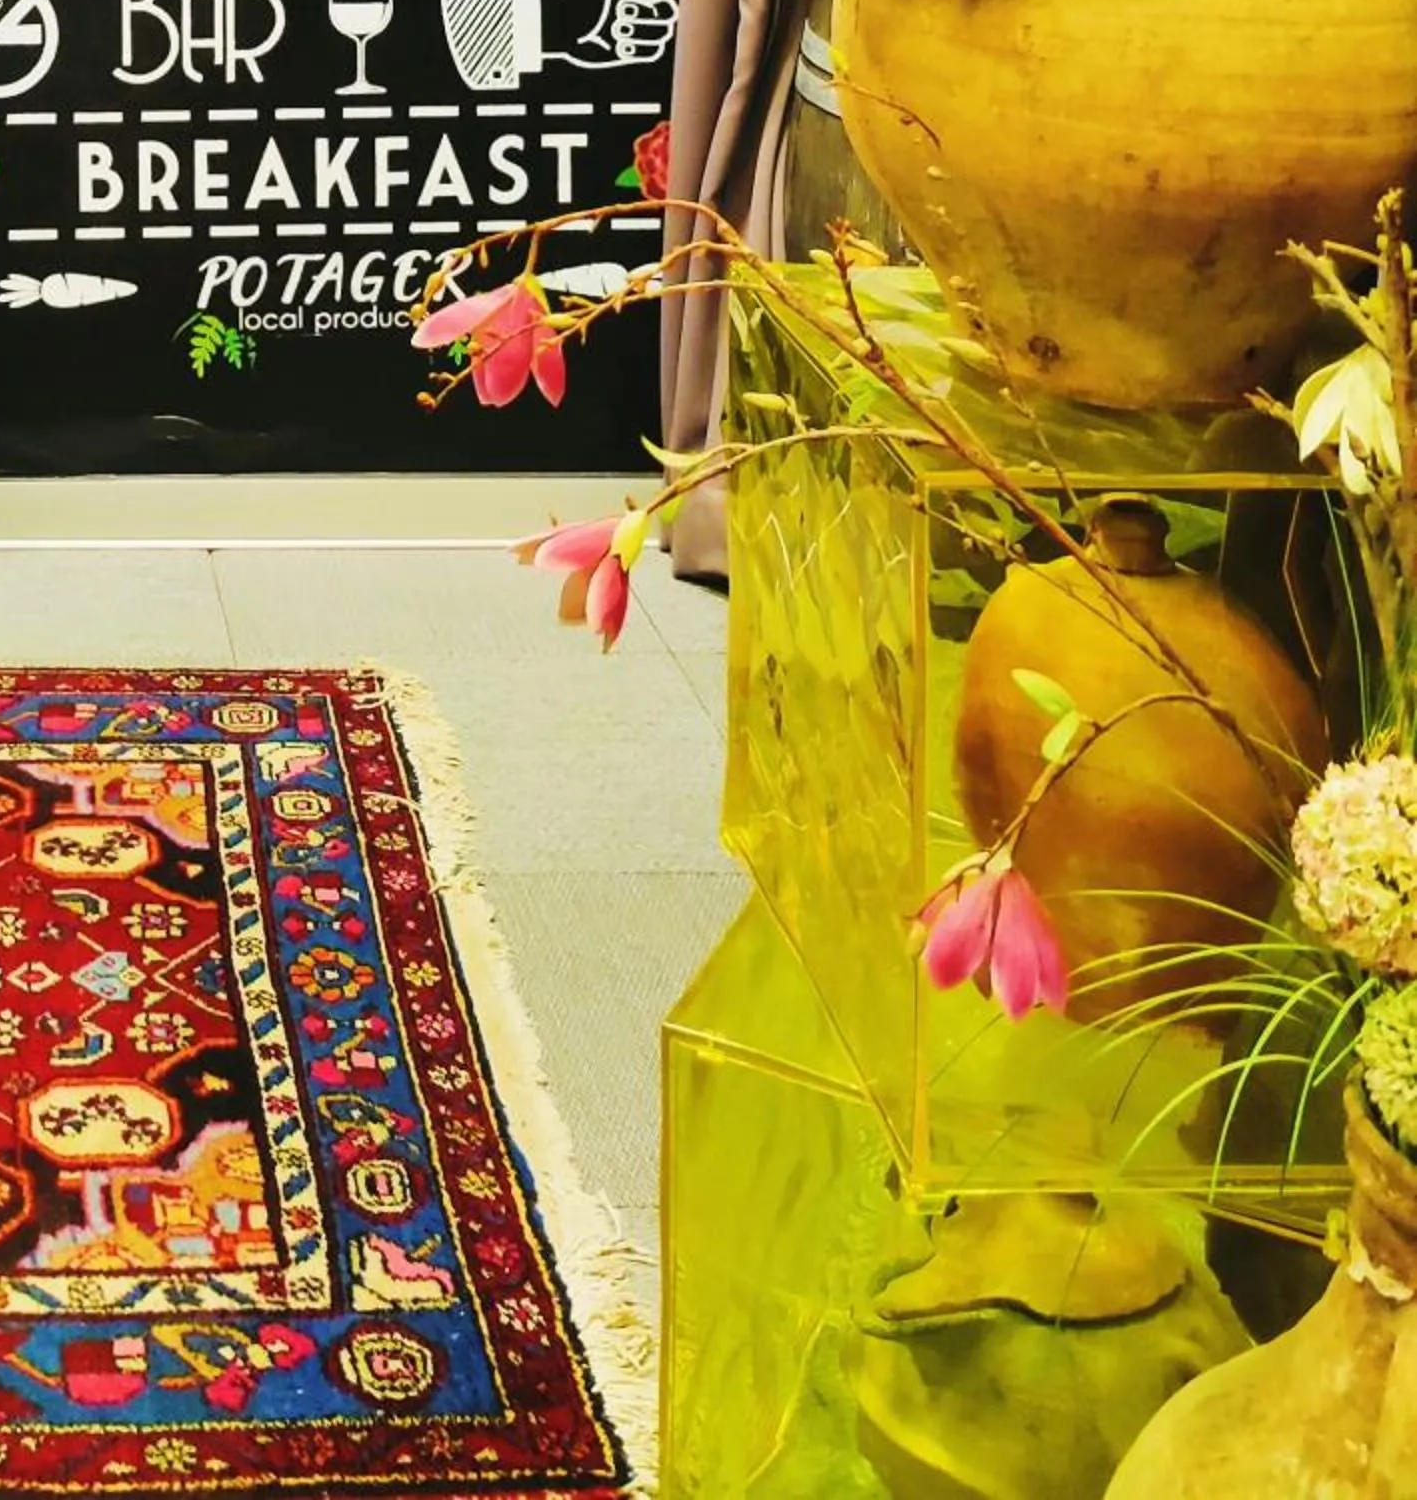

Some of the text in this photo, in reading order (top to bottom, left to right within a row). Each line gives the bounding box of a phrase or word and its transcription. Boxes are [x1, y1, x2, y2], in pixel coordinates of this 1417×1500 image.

[78, 133, 589, 213] BREAKFAST
[196, 250, 474, 310] POTAGER
[234, 303, 411, 335] local produc
